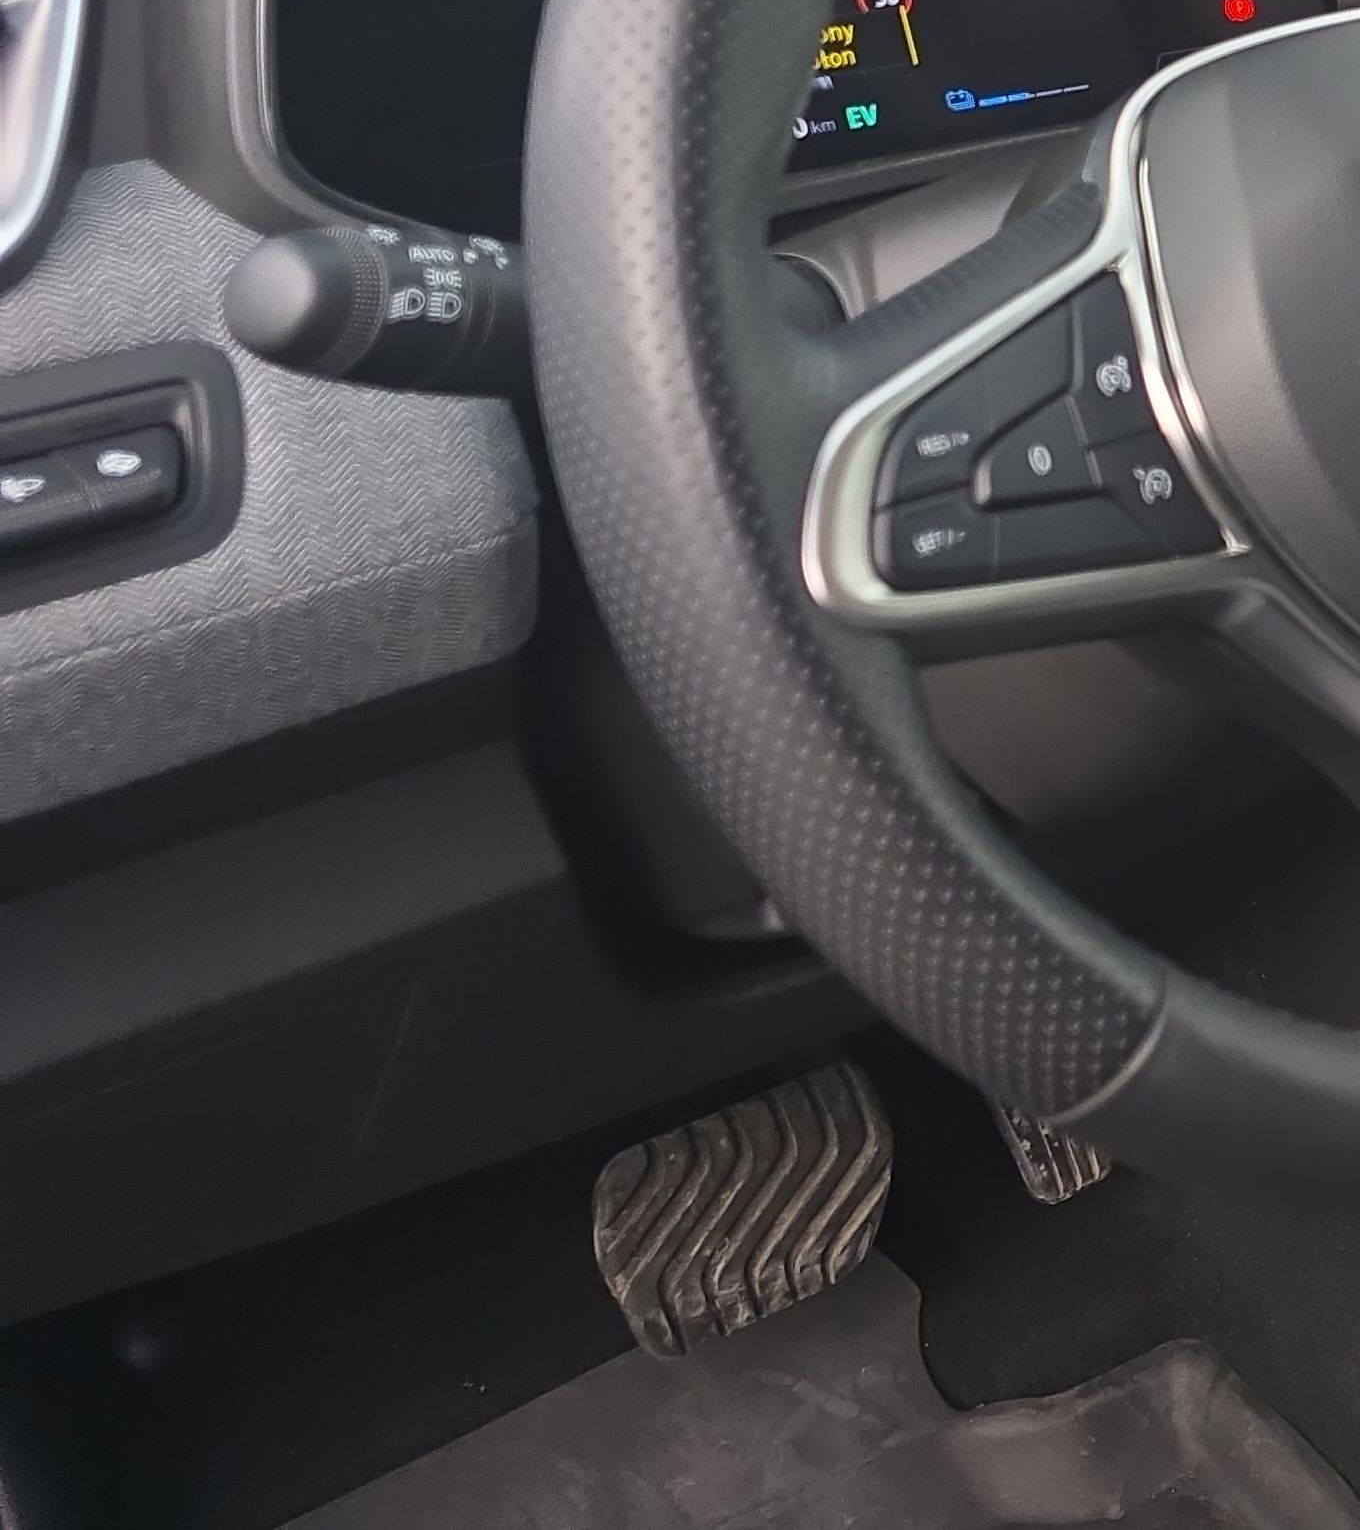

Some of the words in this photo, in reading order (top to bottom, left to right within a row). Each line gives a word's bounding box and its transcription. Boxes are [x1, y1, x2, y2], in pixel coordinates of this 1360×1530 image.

[812, 49, 857, 70] ton
[845, 103, 877, 130] EV
[810, 120, 837, 134] km
[412, 246, 456, 263] AUTO
